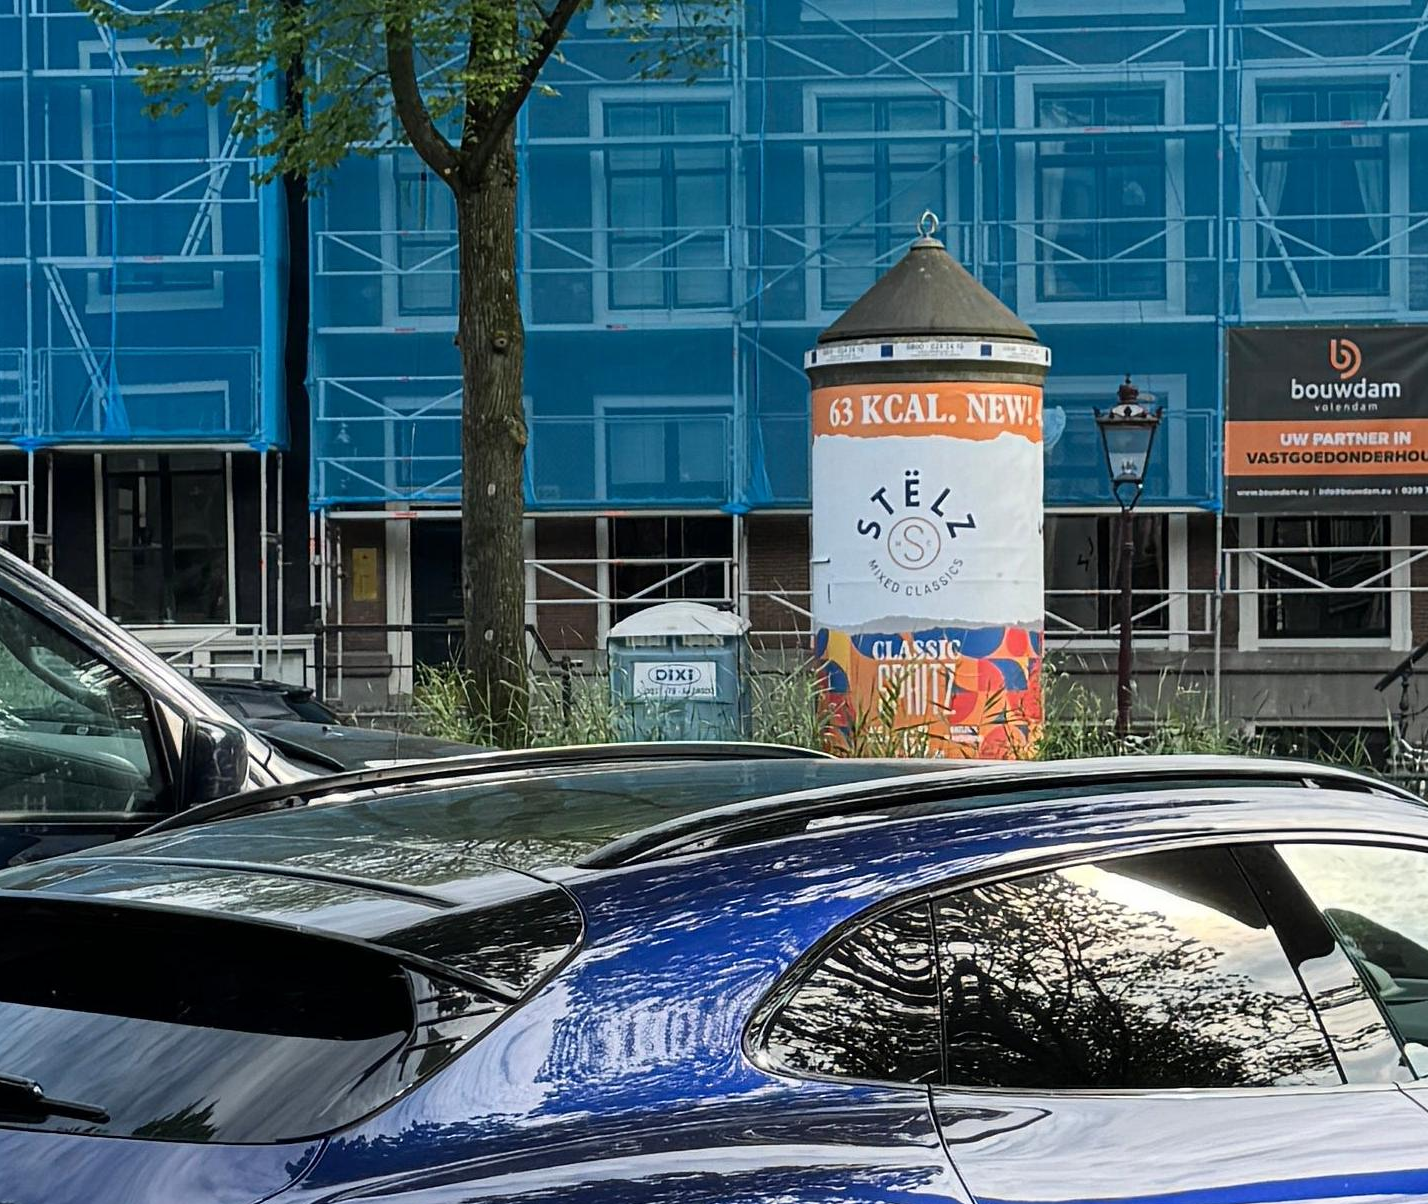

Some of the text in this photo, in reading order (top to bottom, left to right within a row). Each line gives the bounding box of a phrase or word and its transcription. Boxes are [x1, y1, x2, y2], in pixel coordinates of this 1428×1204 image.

[1291, 377, 1401, 400] bouwdam
[829, 396, 854, 428] 63
[860, 393, 957, 426] KCAL.
[966, 394, 1033, 426] NEW!
[1314, 402, 1379, 413] volendam
[1280, 430, 1412, 447] UW PARTNER IN
[857, 469, 977, 540] STËLZ
[868, 558, 964, 597] MIXED CLASSICS
[872, 639, 960, 660] CLASSIC
